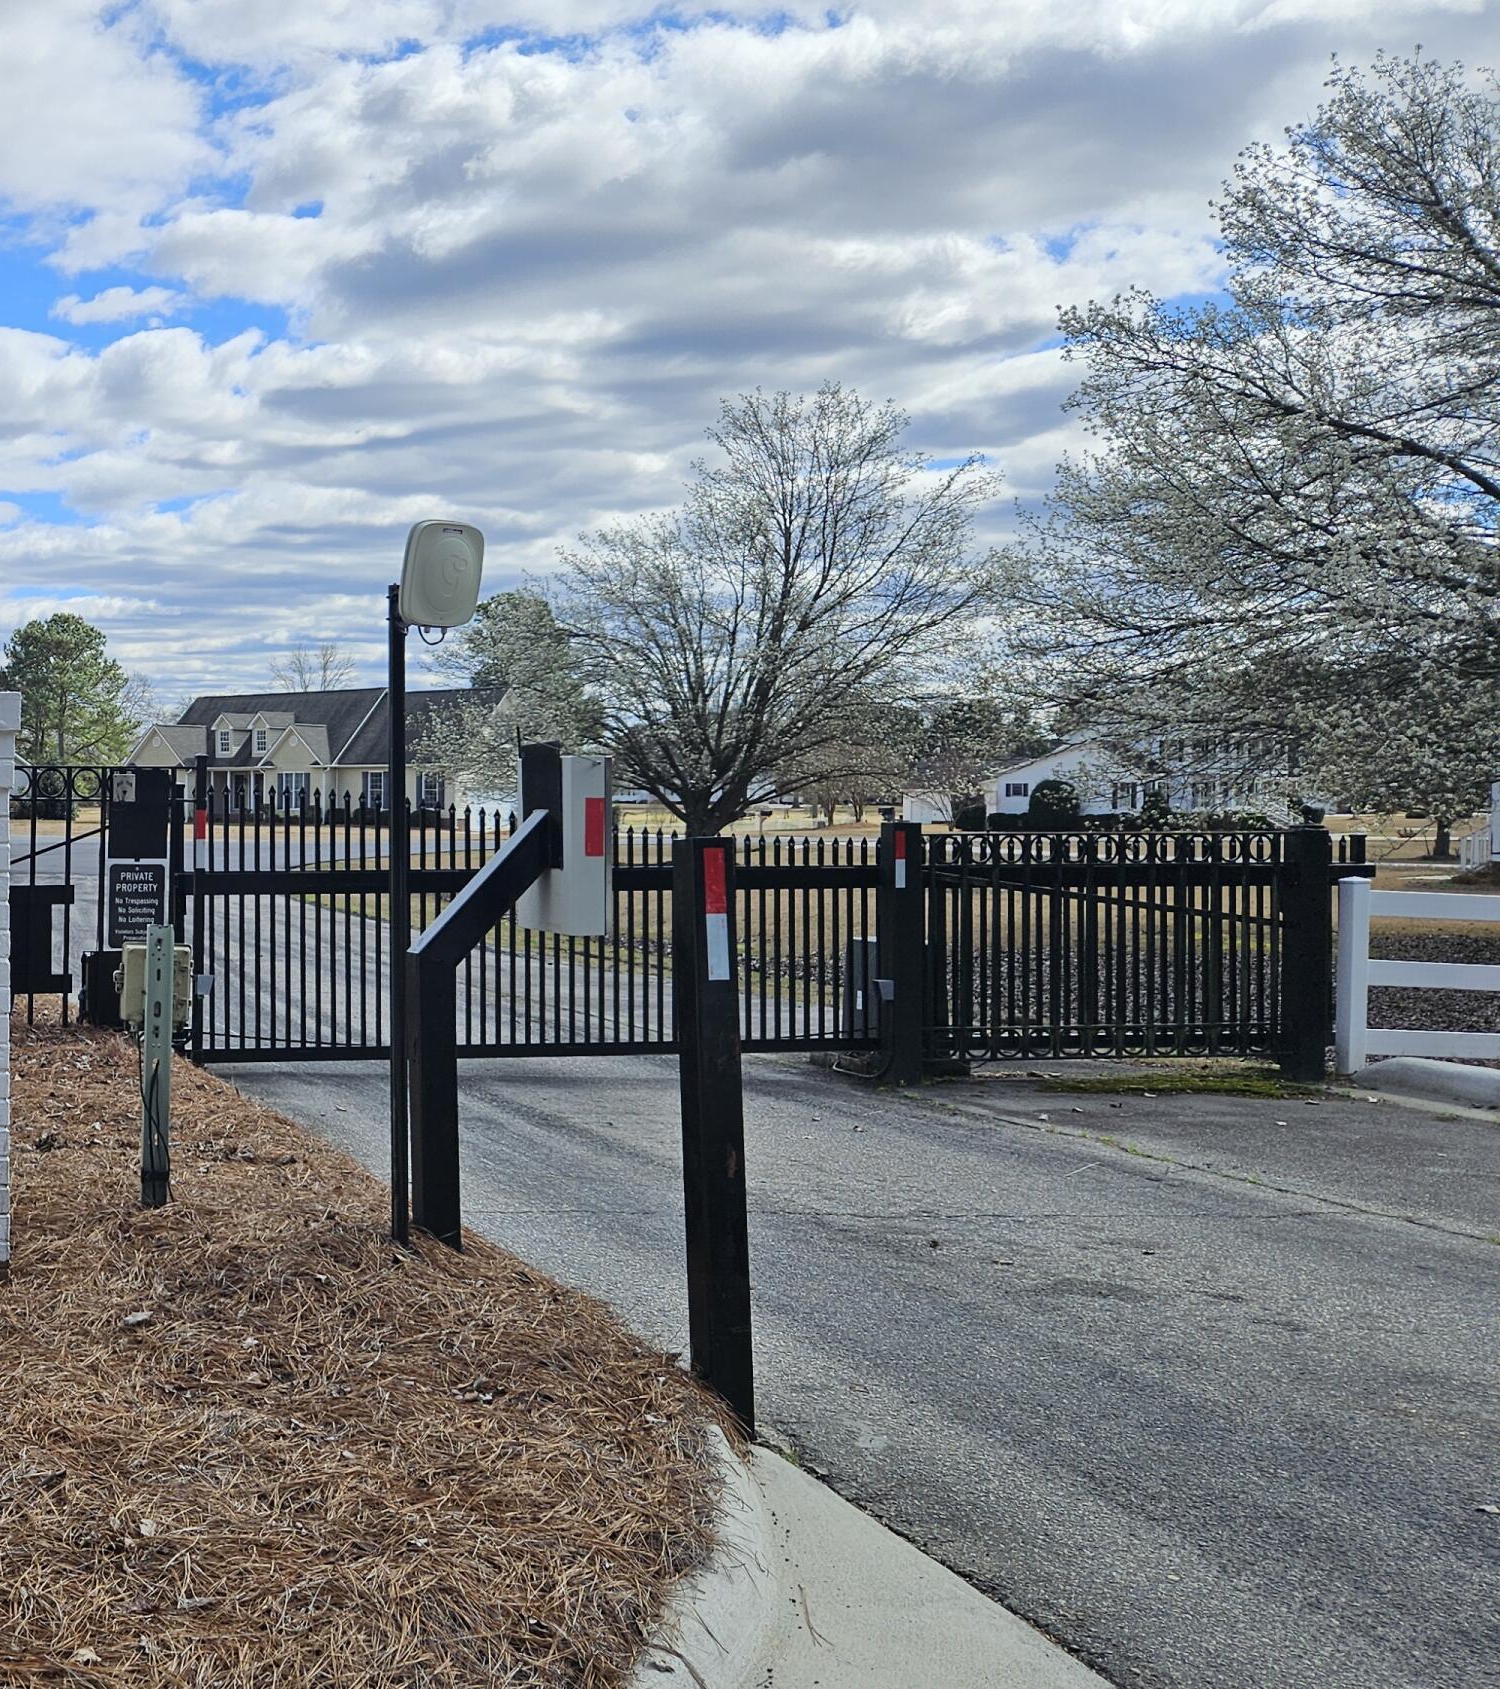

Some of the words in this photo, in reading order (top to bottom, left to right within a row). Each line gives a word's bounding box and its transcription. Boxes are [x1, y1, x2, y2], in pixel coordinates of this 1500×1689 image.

[121, 872, 153, 880] PRIVATE
[116, 884, 157, 892] PROPERTY
[125, 897, 158, 905] Trespassing
[128, 916, 154, 924] Loitering
